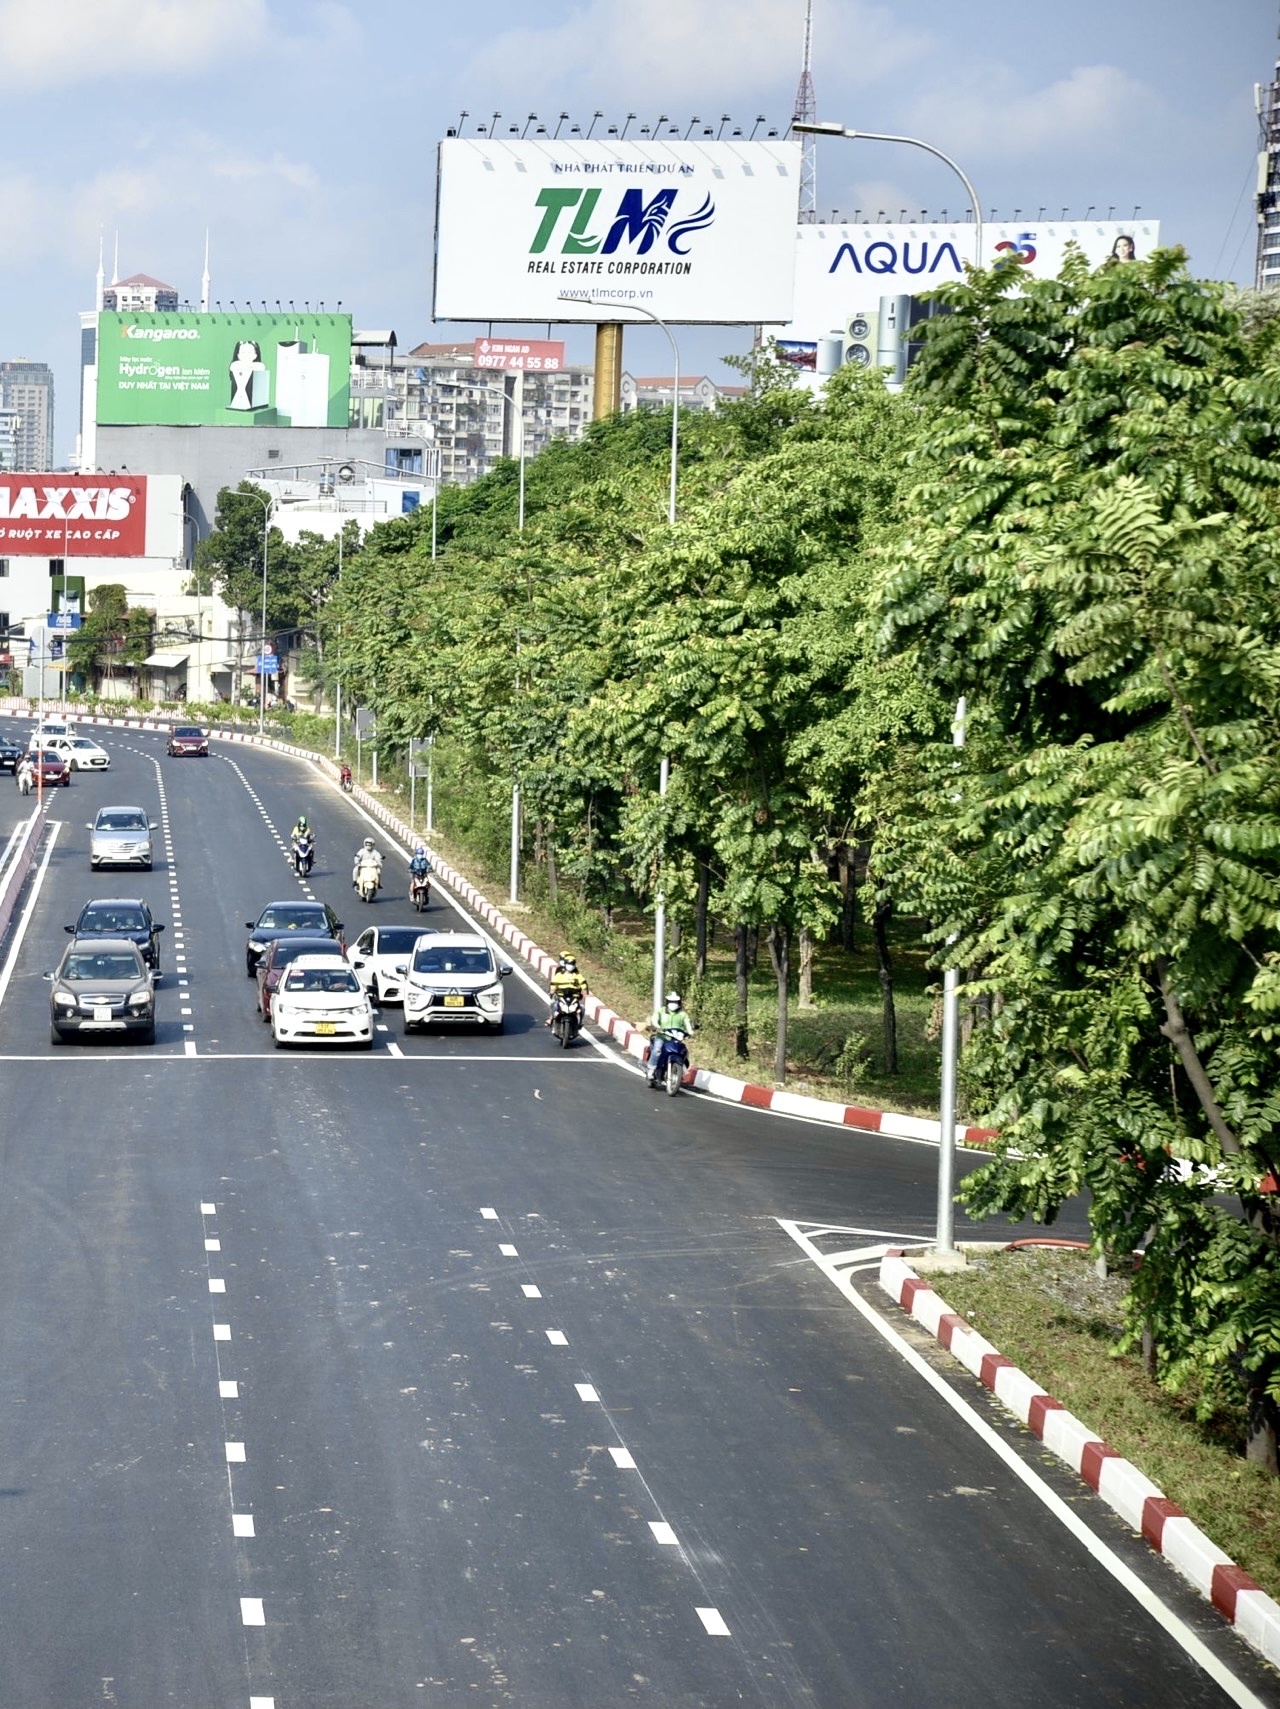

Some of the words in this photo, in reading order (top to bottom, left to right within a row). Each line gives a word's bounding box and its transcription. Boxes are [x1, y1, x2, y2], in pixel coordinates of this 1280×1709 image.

[828, 241, 963, 275] AQUA
[527, 261, 556, 274] REAL
[561, 261, 604, 274] ESTATE
[608, 261, 692, 275] CORPORATION
[559, 288, 654, 299] www.tlmcorp.vn
[120, 324, 198, 342] Kangaroo
[477, 354, 507, 367] 0977
[509, 356, 524, 368] 44
[526, 357, 542, 369] 55
[543, 357, 559, 370] 88
[119, 362, 181, 378] Hydrogen
[118, 381, 135, 389] DUY
[190, 382, 210, 390] NAM
[44, 529, 63, 539] XE
[65, 530, 92, 540] CAO
